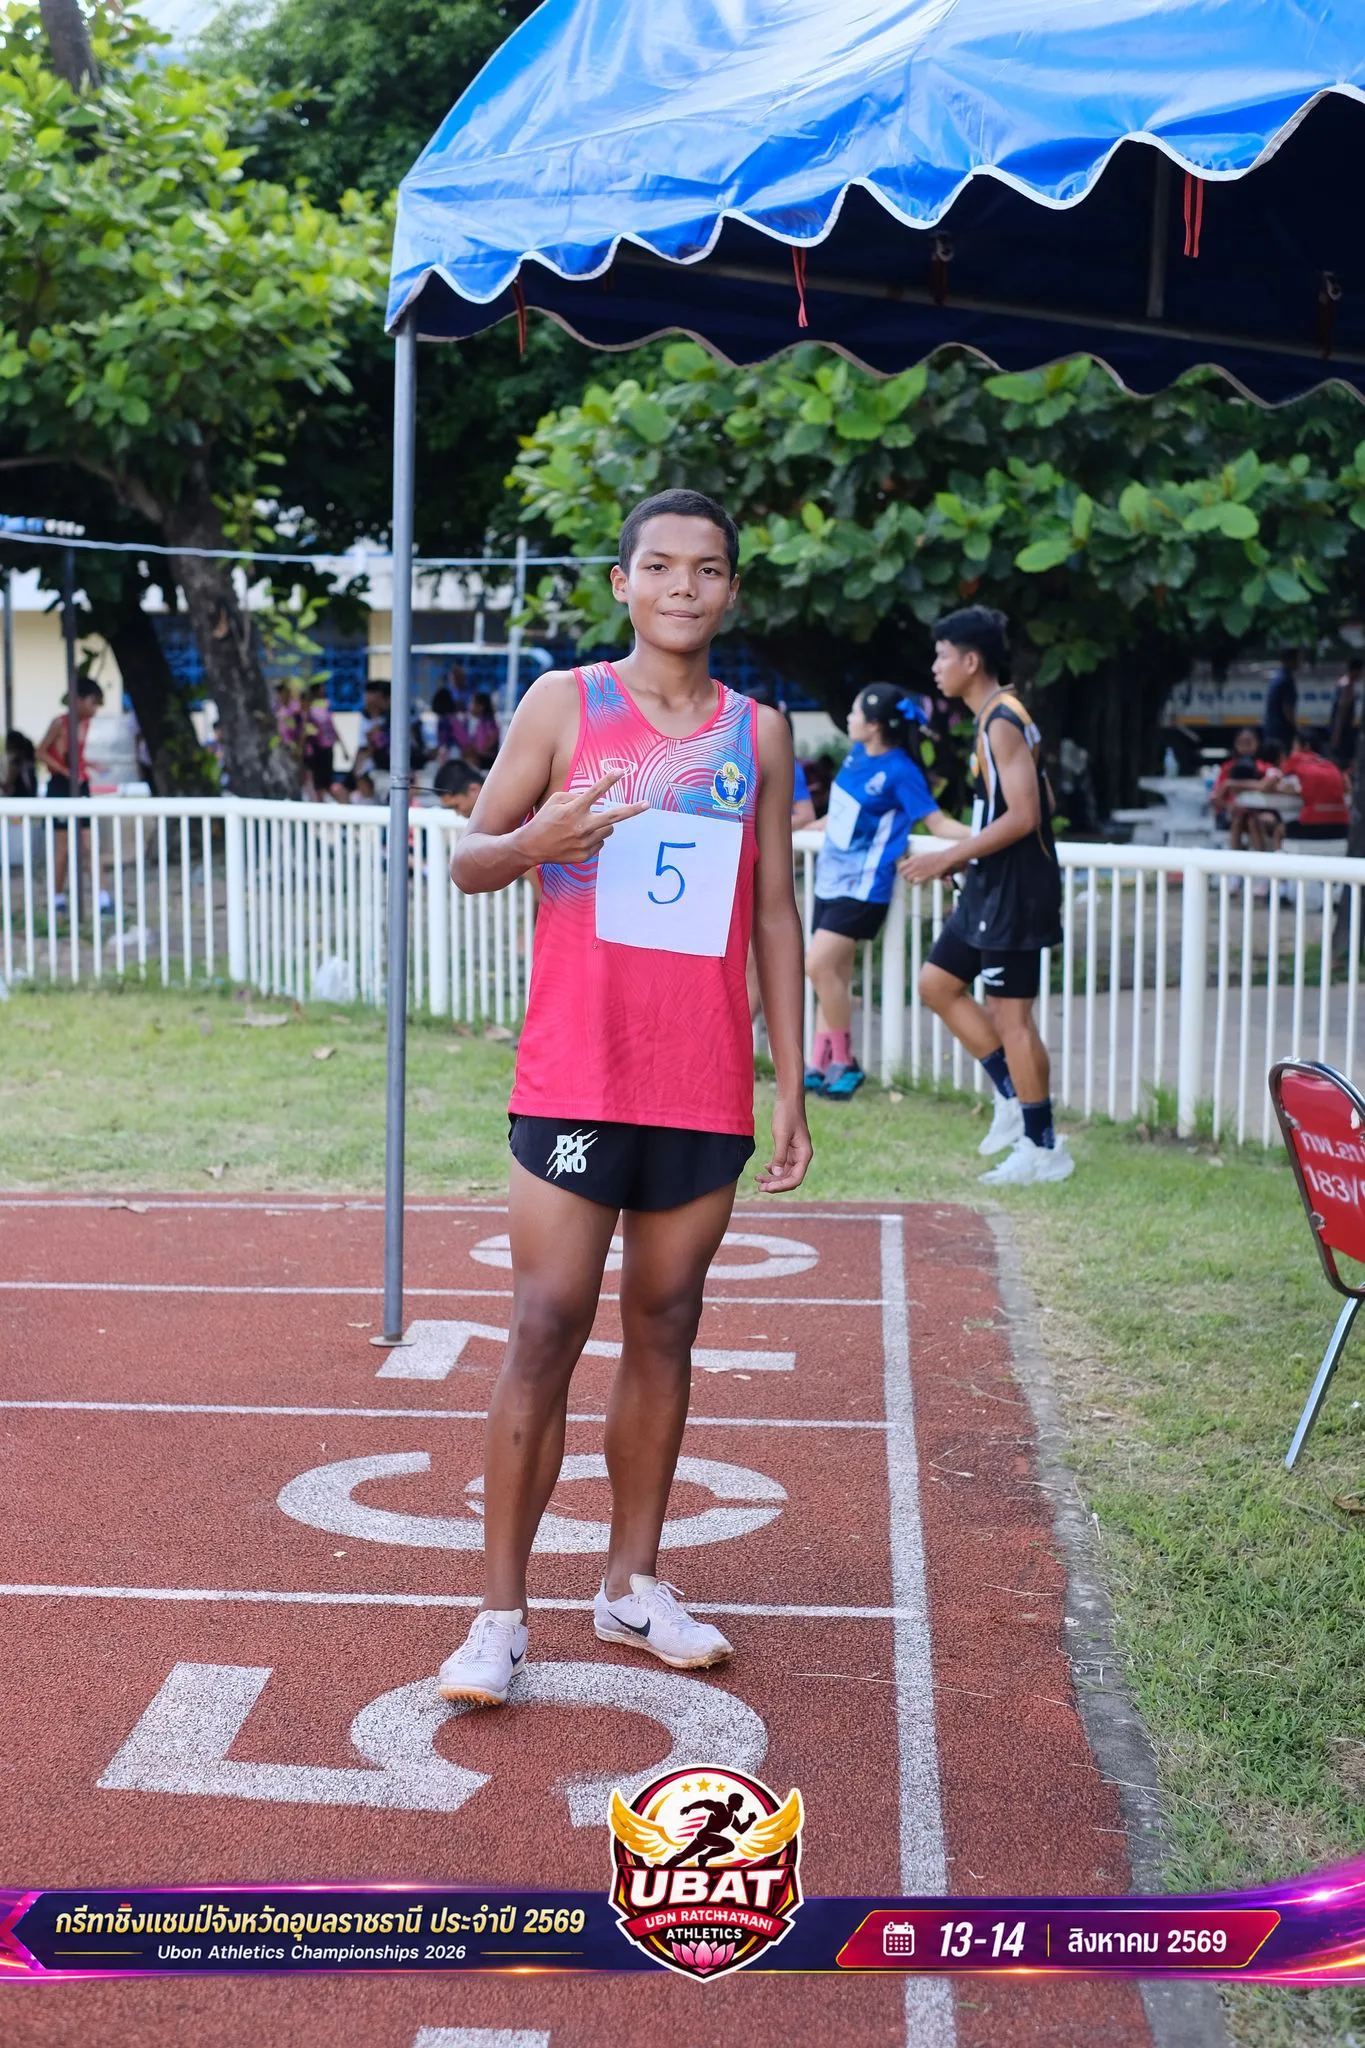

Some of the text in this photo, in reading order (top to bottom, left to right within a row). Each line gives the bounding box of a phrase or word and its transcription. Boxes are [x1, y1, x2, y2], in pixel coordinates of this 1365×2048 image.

[648, 841, 696, 905] 5
[1304, 1164, 1365, 1207] 183/
[276, 1451, 788, 1555] 6
[95, 1661, 768, 1828] 5
